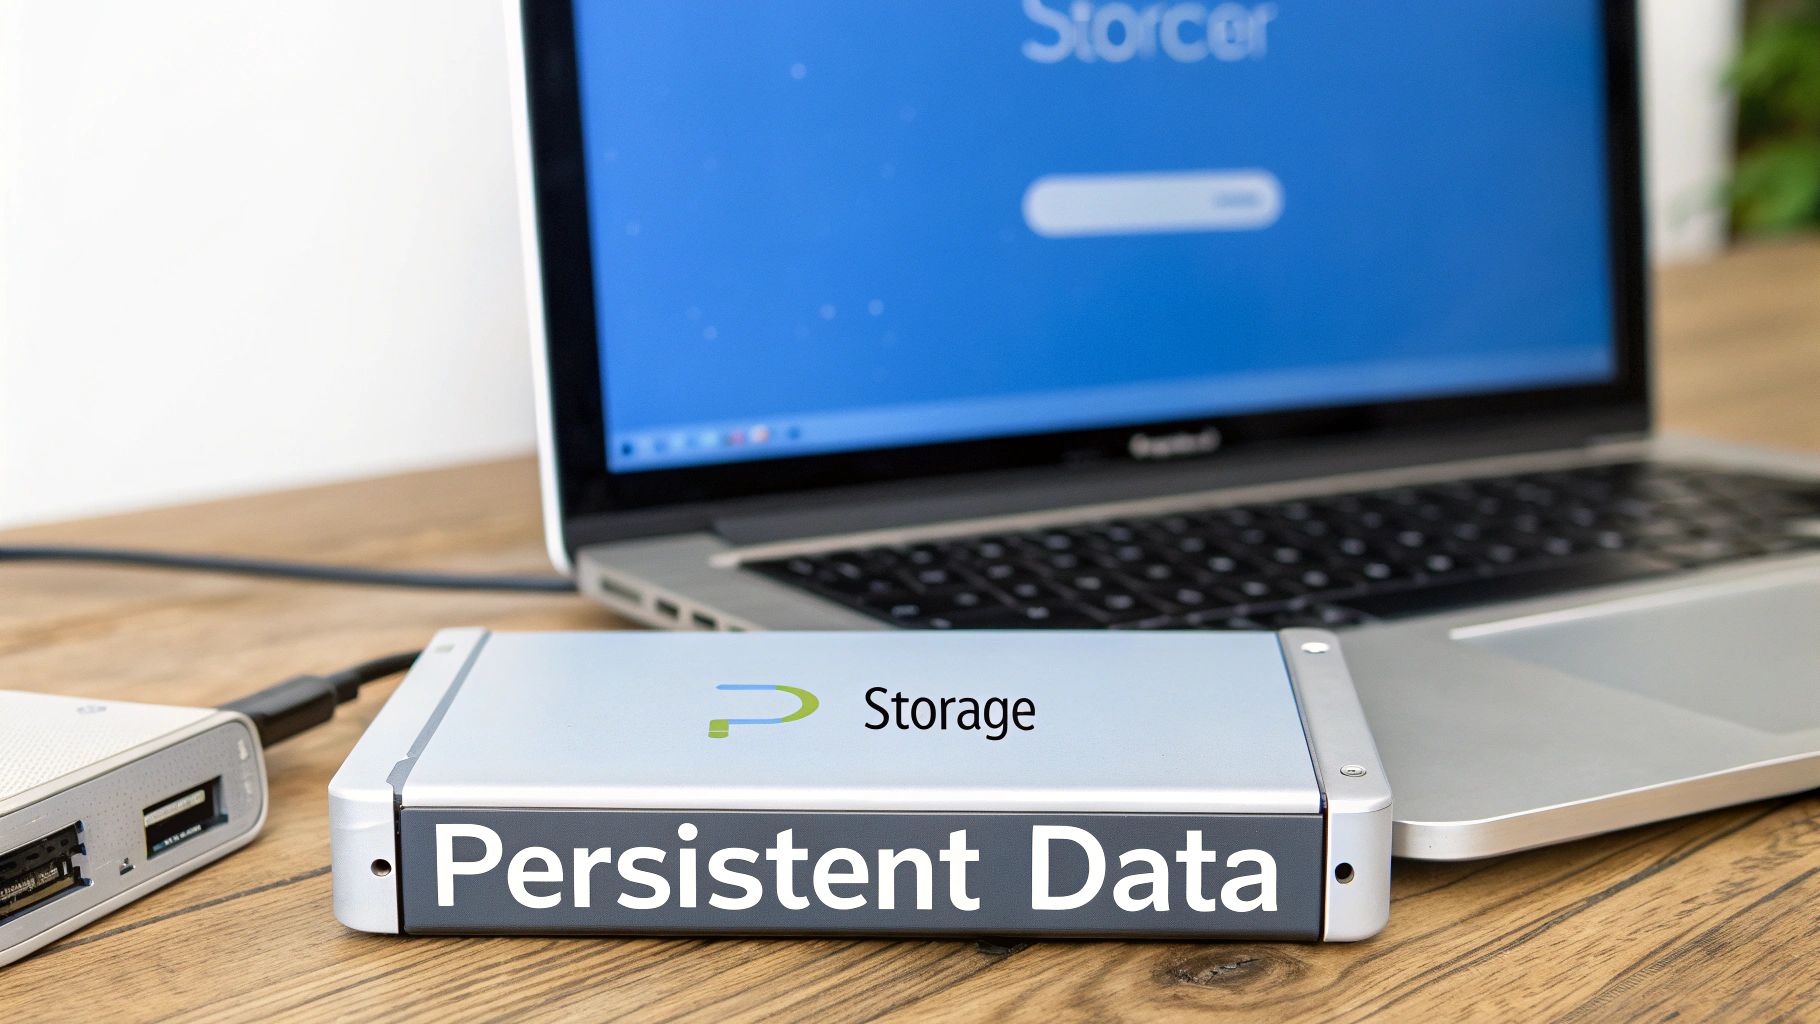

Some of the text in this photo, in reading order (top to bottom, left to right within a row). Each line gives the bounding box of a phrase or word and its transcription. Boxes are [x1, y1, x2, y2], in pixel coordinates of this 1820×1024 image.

[864, 686, 1036, 741] Storage
[435, 823, 1279, 913] Persistent Data
